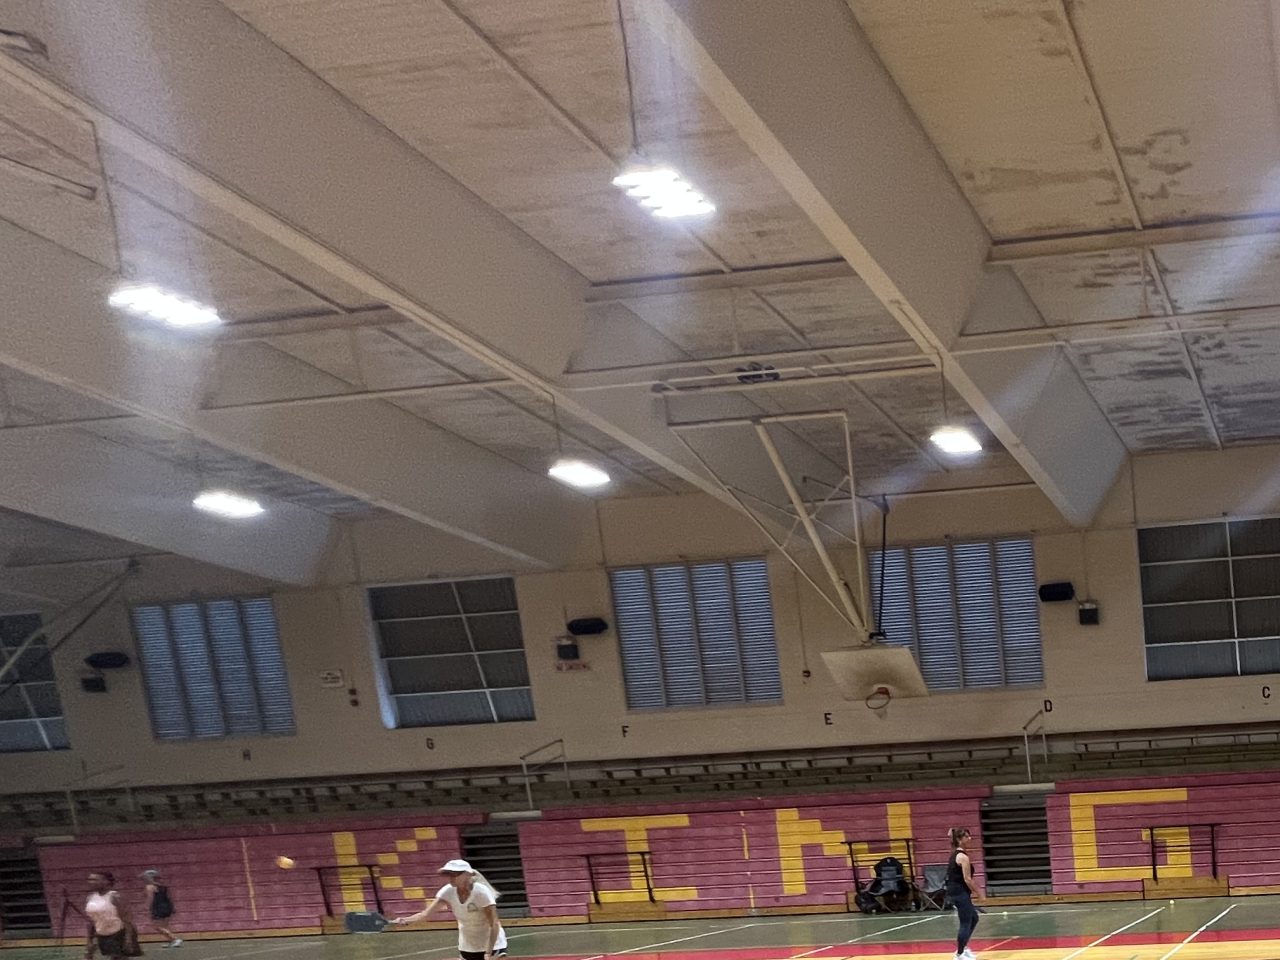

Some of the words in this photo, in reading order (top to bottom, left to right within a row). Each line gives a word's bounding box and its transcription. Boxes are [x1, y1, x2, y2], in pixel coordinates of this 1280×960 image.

[1262, 686, 1271, 699] C
[1043, 699, 1053, 712] D
[824, 712, 833, 725] E
[621, 725, 630, 738] F
[426, 737, 435, 750] G
